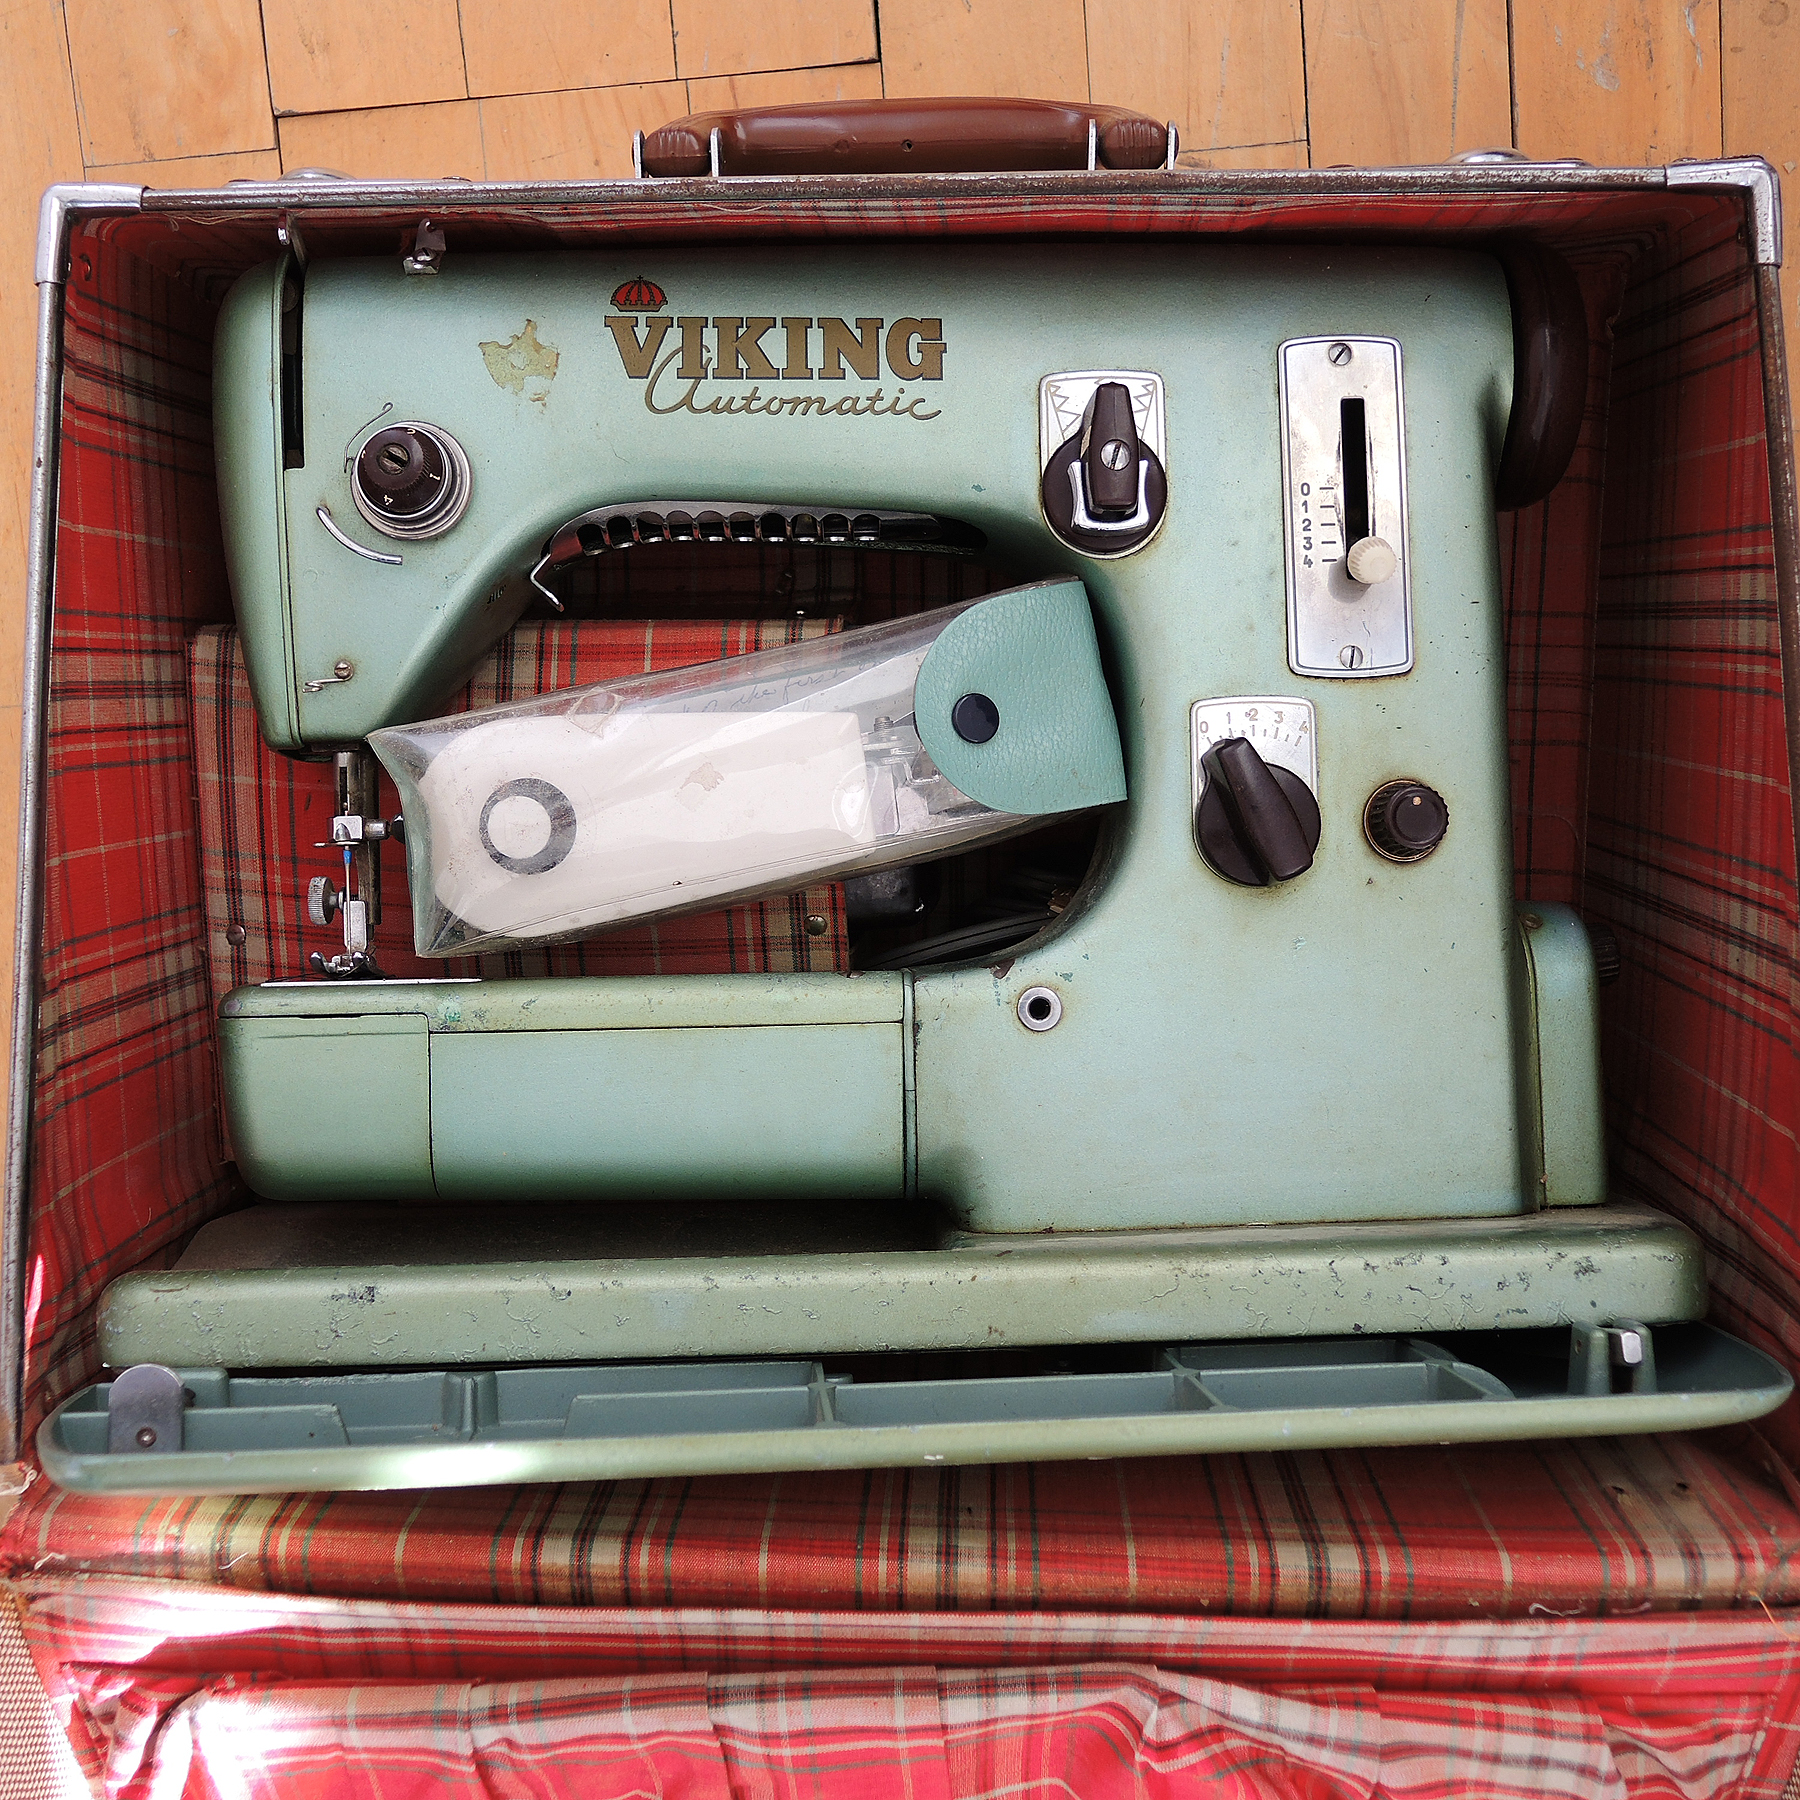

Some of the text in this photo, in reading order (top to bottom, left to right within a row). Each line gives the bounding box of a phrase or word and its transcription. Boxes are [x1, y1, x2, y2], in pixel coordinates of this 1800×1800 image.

[604, 315, 947, 380] VIKING
[645, 344, 942, 420] Automatic
[1300, 482, 1311, 496] 0
[1301, 500, 1309, 513] 1
[1302, 518, 1312, 532] 2
[1302, 536, 1313, 551] 3
[1303, 554, 1314, 568] 4
[1200, 707, 1309, 734] 0 1 2 3 4
